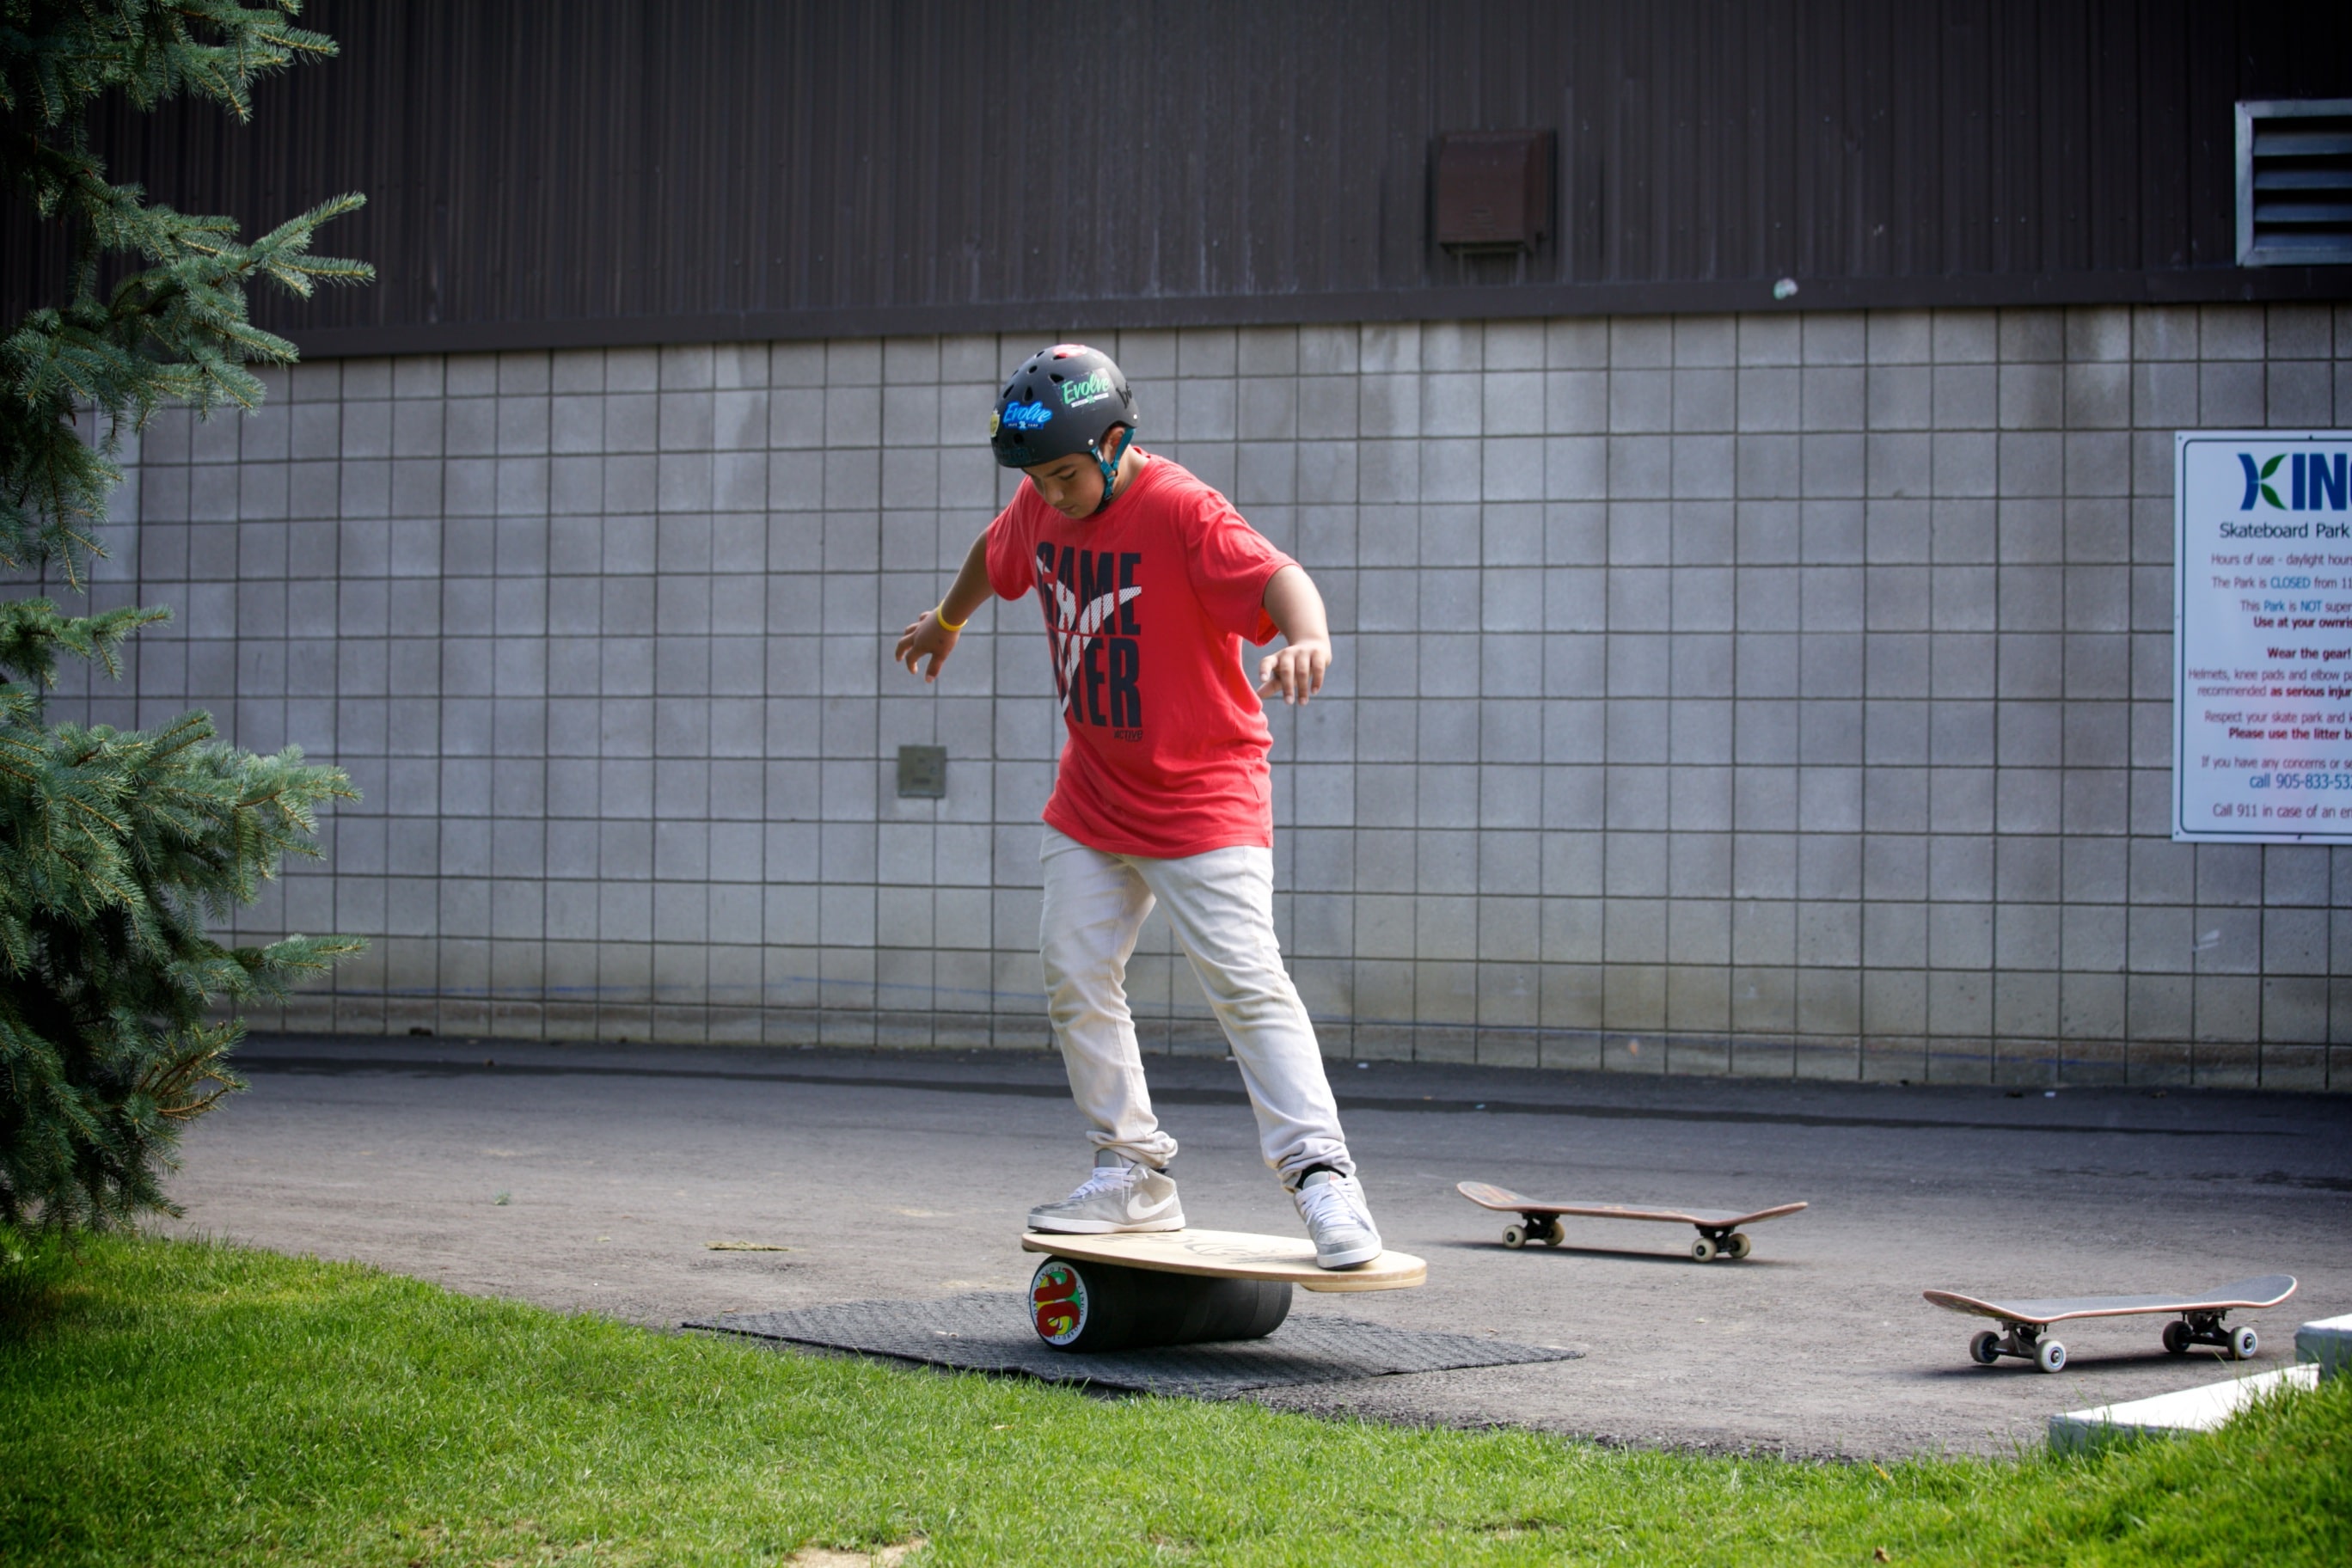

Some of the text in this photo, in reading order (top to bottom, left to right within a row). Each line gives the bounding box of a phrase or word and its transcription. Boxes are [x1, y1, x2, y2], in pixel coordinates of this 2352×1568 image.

[1061, 371, 1110, 405] Evolve
[1003, 401, 1053, 424] Evolve
[2237, 452, 2352, 511] KIN
[2220, 522, 2350, 539] Skateboard Park
[2211, 553, 2239, 566] Hours
[2244, 553, 2255, 566] of
[2257, 555, 2274, 566] use
[2286, 553, 2324, 568] daylight
[1036, 541, 1142, 636] GAME
[2212, 577, 2231, 589] The
[2234, 577, 2255, 589] Park
[2259, 577, 2267, 589] is
[2270, 577, 2311, 590] CLOSED
[2314, 577, 2337, 589] from
[2240, 600, 2260, 613] This
[2263, 600, 2285, 613] Park
[2289, 600, 2296, 613] is
[2300, 600, 2322, 613] NOT
[2254, 616, 2274, 628] Use
[2277, 616, 2288, 628] at
[2292, 618, 2315, 630] your
[2268, 647, 2351, 662] Wear the gear!
[2189, 669, 2230, 682] Helmets,
[2234, 669, 2257, 681] knee
[2262, 670, 2285, 683] pads
[2288, 670, 2306, 681] and
[2311, 669, 2339, 681] elbow
[2197, 686, 2266, 697] recommended
[2270, 689, 2282, 697] as
[2286, 686, 2324, 697] serious
[2204, 711, 2242, 725] Respect
[2246, 714, 2268, 725] your
[2271, 711, 2298, 724] skate
[2301, 712, 2323, 725] park
[2326, 712, 2345, 724] and
[2228, 727, 2264, 740] Please
[2268, 730, 2288, 740] use
[2292, 727, 2310, 740] the
[2314, 727, 2340, 740] litter
[2202, 756, 2209, 768] If
[2213, 759, 2231, 770] you
[2234, 756, 2257, 768] have
[2261, 759, 2279, 771] any
[2282, 759, 2326, 769] concerns
[2330, 759, 2340, 769] or
[2250, 775, 2270, 789] call
[2213, 804, 2233, 818] Call
[2237, 805, 2257, 818] 911
[2263, 805, 2273, 818] in
[2276, 807, 2301, 818] case
[2306, 803, 2318, 818] of
[2322, 807, 2336, 818] an
